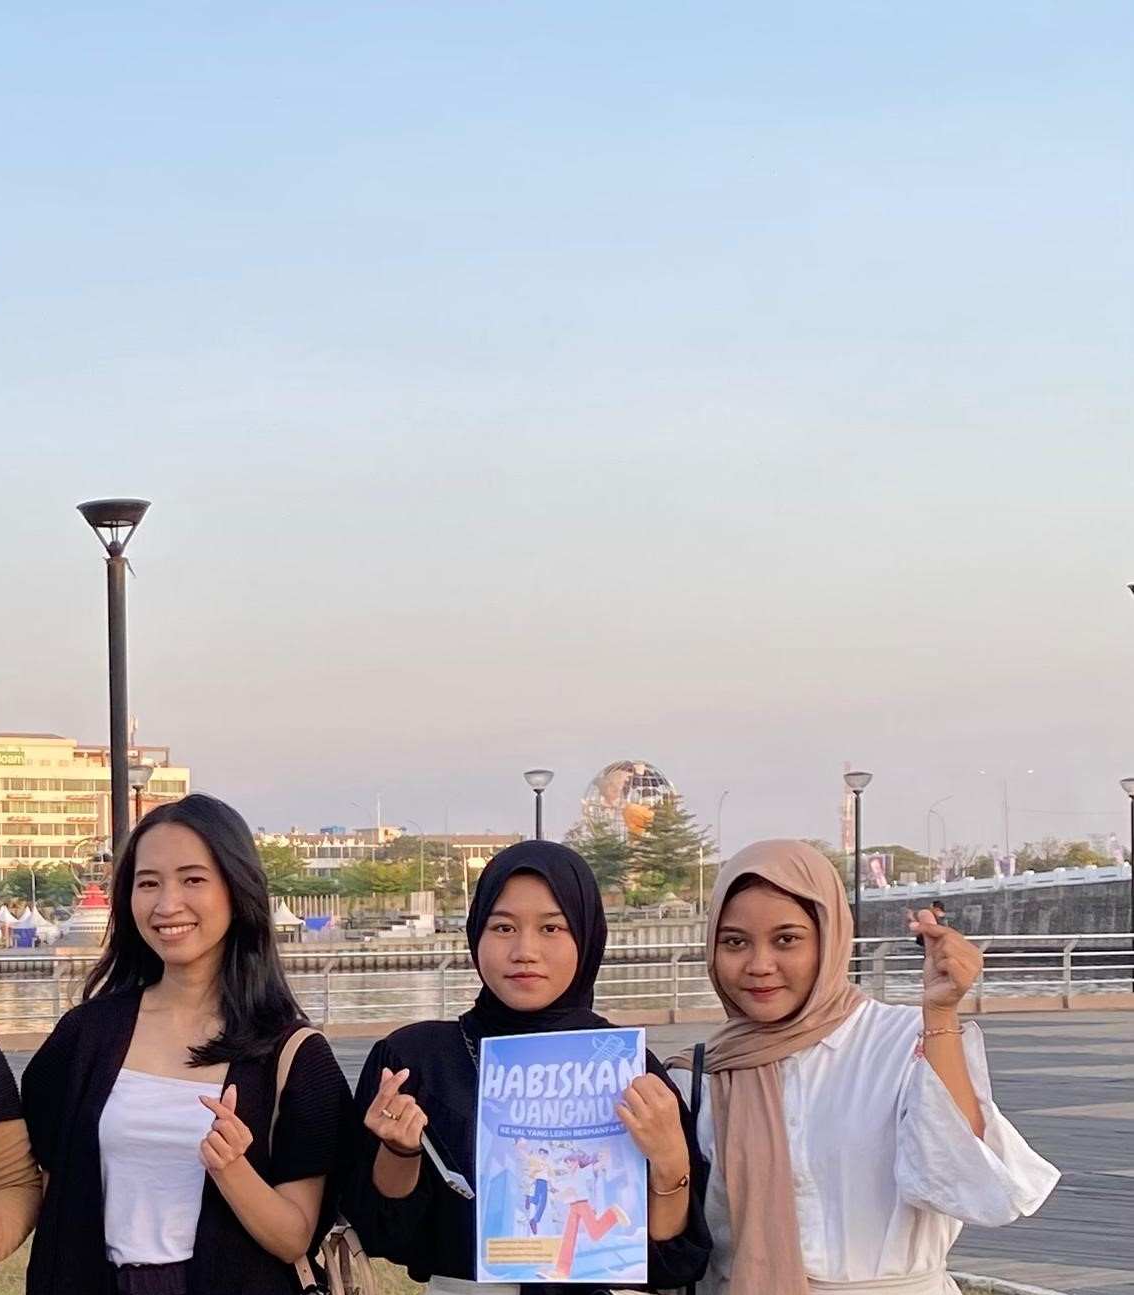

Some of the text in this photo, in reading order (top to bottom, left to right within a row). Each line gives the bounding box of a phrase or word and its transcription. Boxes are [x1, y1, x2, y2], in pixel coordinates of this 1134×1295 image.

[483, 1059, 643, 1100] HABISKAN
[510, 1097, 612, 1125] UANGMU
[526, 1128, 549, 1138] YANG
[572, 1124, 625, 1137] BERMANFAA
